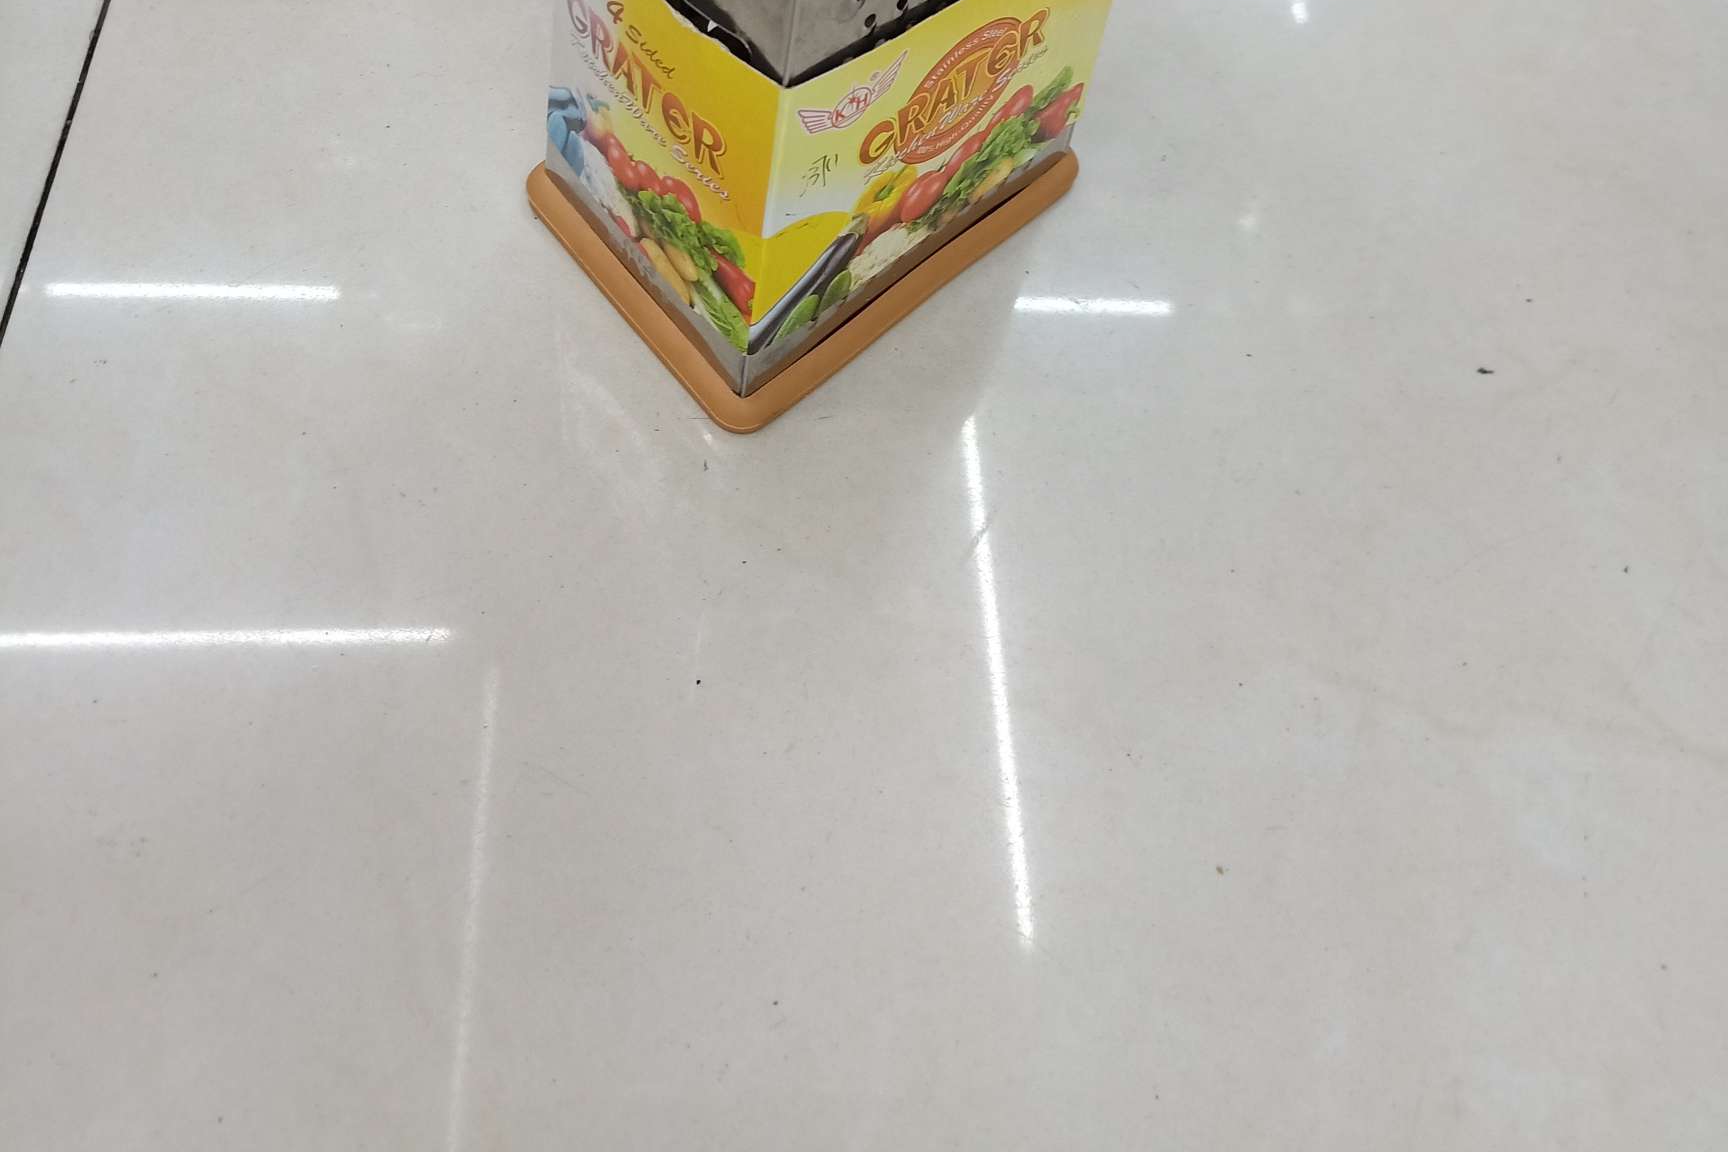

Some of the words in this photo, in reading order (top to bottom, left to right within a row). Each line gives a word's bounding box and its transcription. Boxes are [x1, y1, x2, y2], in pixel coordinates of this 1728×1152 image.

[606, 0, 625, 25] 4
[625, 24, 676, 80] Sided
[923, 37, 979, 90] Stainless
[859, 6, 1051, 165] GRATER
[671, 143, 731, 202] Series
